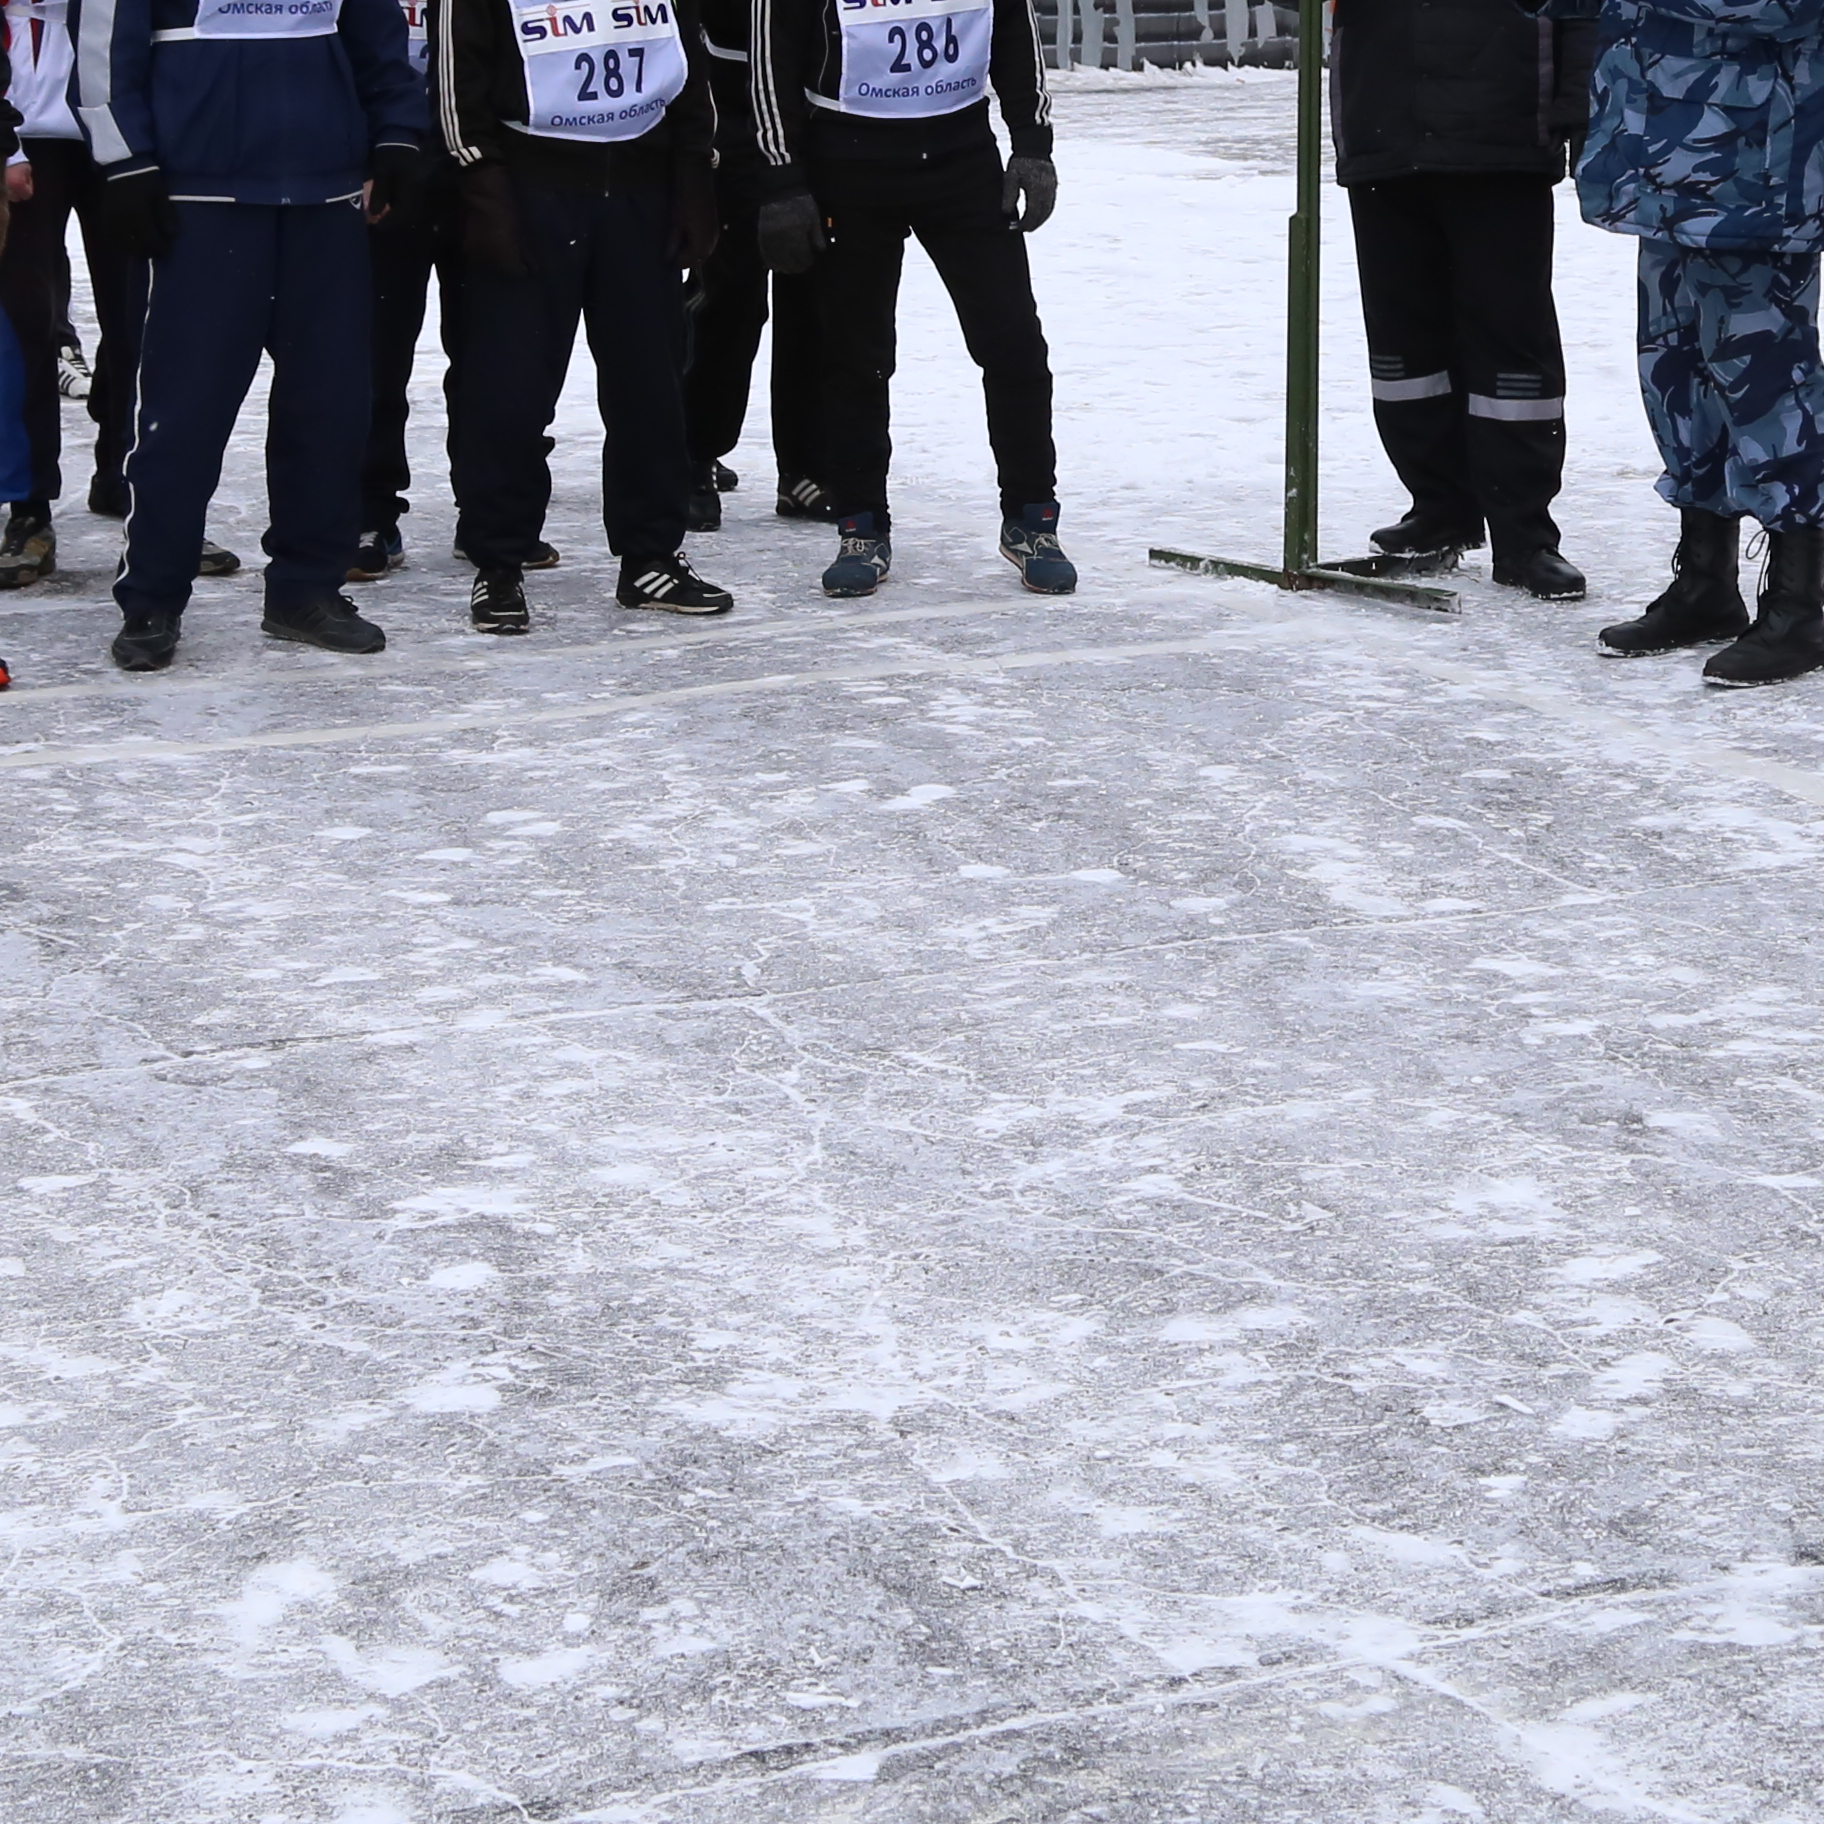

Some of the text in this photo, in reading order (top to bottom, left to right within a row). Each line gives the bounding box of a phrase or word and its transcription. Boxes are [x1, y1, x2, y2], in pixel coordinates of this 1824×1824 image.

[888, 16, 960, 74] 286
[574, 47, 646, 102] 287
[858, 76, 977, 99] Омская область
[551, 96, 667, 127] Омская область
